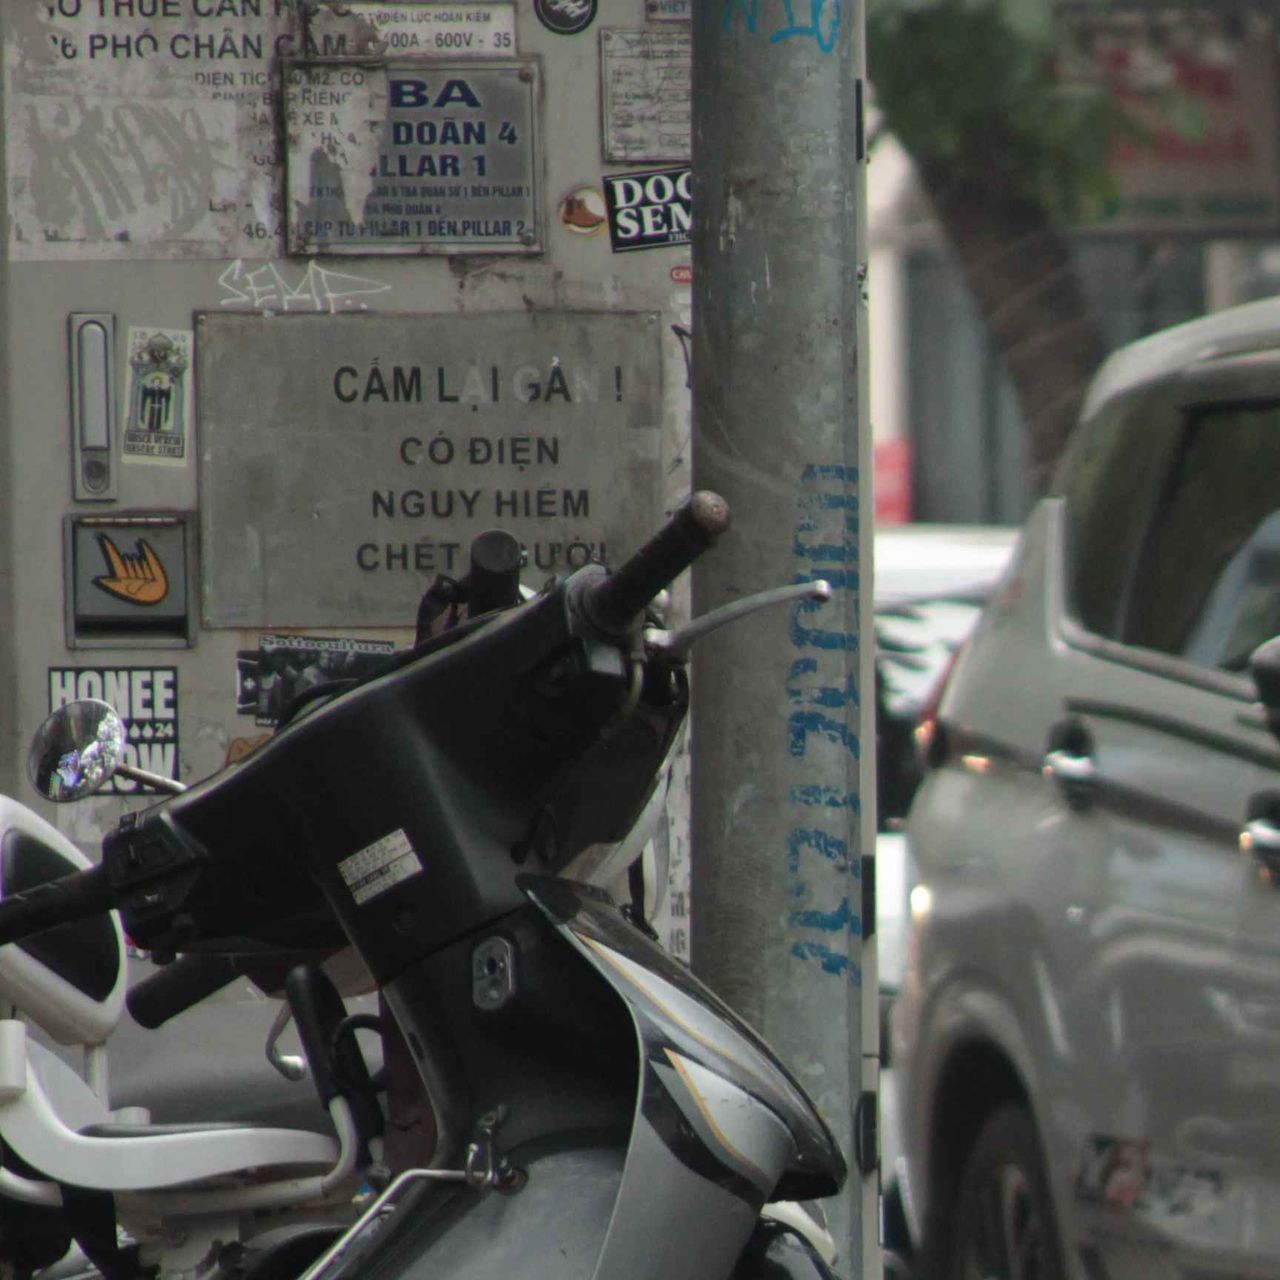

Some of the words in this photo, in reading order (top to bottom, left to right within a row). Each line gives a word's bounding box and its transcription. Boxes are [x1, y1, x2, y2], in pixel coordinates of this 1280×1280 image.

[434, 32, 473, 48] 600V
[493, 32, 512, 48] 35
[393, 117, 486, 145] DOÃN
[498, 121, 518, 145] 4
[473, 154, 486, 177] 1
[461, 220, 511, 236] PILLAR
[516, 220, 526, 237] 2
[333, 356, 422, 404] CẤM
[399, 430, 455, 466] CÓ
[467, 433, 560, 472] ĐIỆN
[372, 489, 482, 519] NGUY
[51, 671, 175, 718] HONEE
[154, 722, 175, 738] 24
